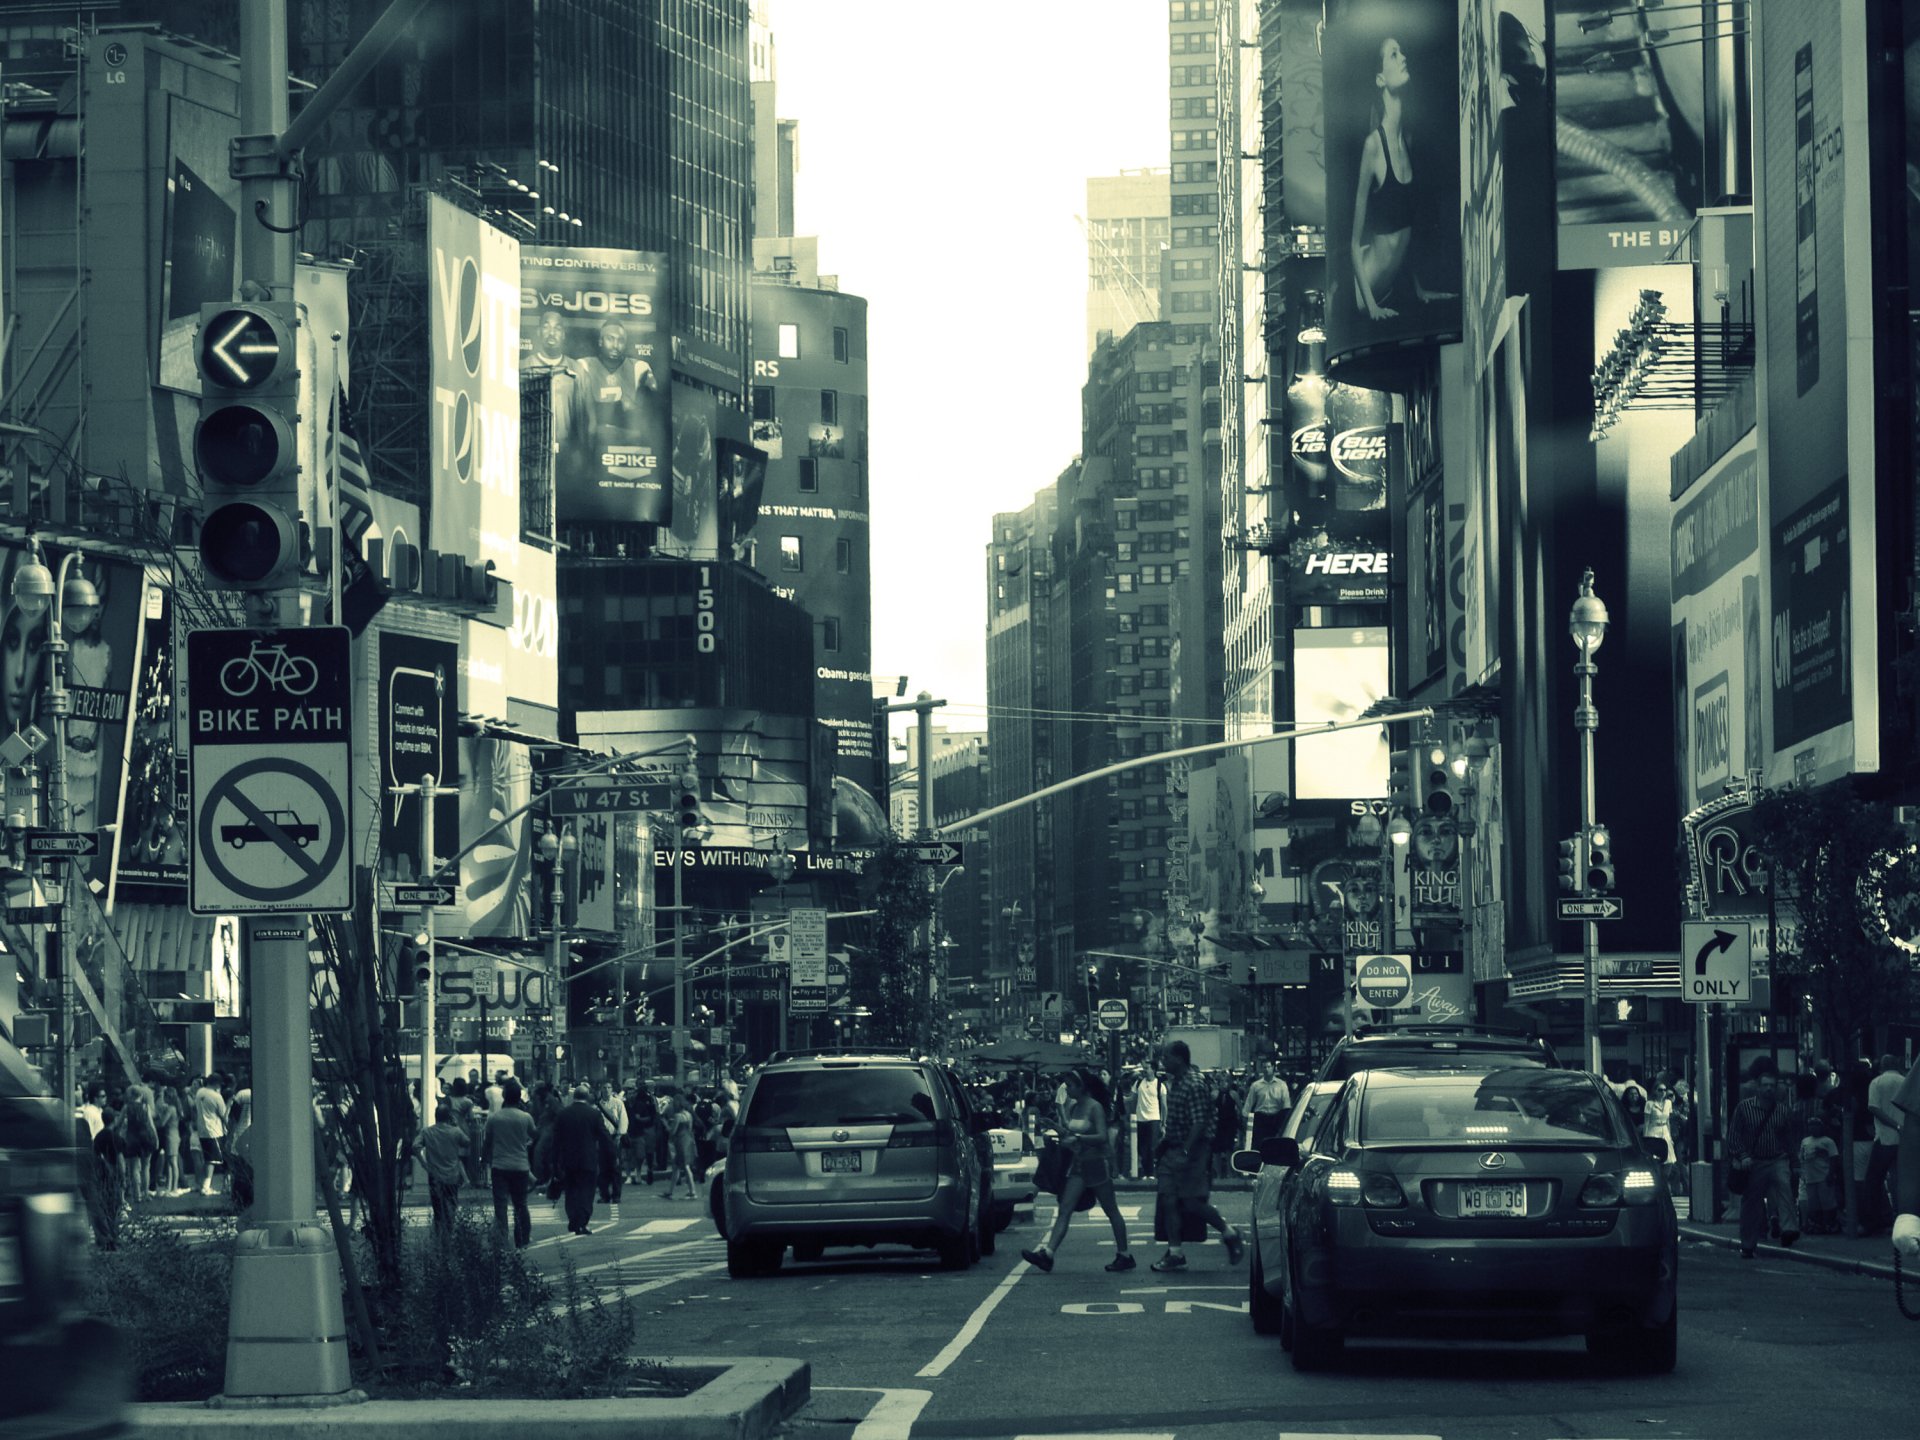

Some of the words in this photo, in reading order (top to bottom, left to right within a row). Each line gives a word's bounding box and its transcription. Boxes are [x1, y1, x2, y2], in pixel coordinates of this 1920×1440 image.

[106, 71, 126, 84] LG
[1608, 231, 1651, 248] THE
[564, 291, 652, 315] JOES
[755, 361, 780, 378] RS
[602, 453, 658, 468] SPIKE
[773, 506, 799, 517] THAT
[799, 507, 837, 521] MATTER,
[1365, 588, 1385, 596] Drink
[697, 566, 715, 654] 1500
[816, 666, 848, 680] Obama
[199, 708, 260, 732] BIKE
[274, 707, 343, 732] PATH
[573, 792, 588, 809] W
[596, 791, 621, 808] 47
[629, 790, 649, 807] St
[36, 839, 57, 849] ONE
[66, 839, 88, 850] WAY
[700, 850, 741, 867] WITH
[807, 854, 834, 870] Live
[929, 849, 952, 858] WAY
[1413, 871, 1458, 886] KING
[403, 891, 420, 901] ONE
[428, 891, 447, 901] WAY
[1414, 886, 1457, 903] TUT
[1566, 904, 1585, 914] ONE
[1592, 904, 1612, 914] WAY
[1346, 921, 1380, 933] KING
[1346, 932, 1380, 948] TUT
[1366, 966, 1380, 976] DO
[1382, 965, 1400, 976] NOT
[1626, 961, 1641, 974] 47
[1368, 989, 1399, 998] ENTER
[1693, 980, 1741, 996] ONLY
[1464, 1191, 1482, 1208] W8
